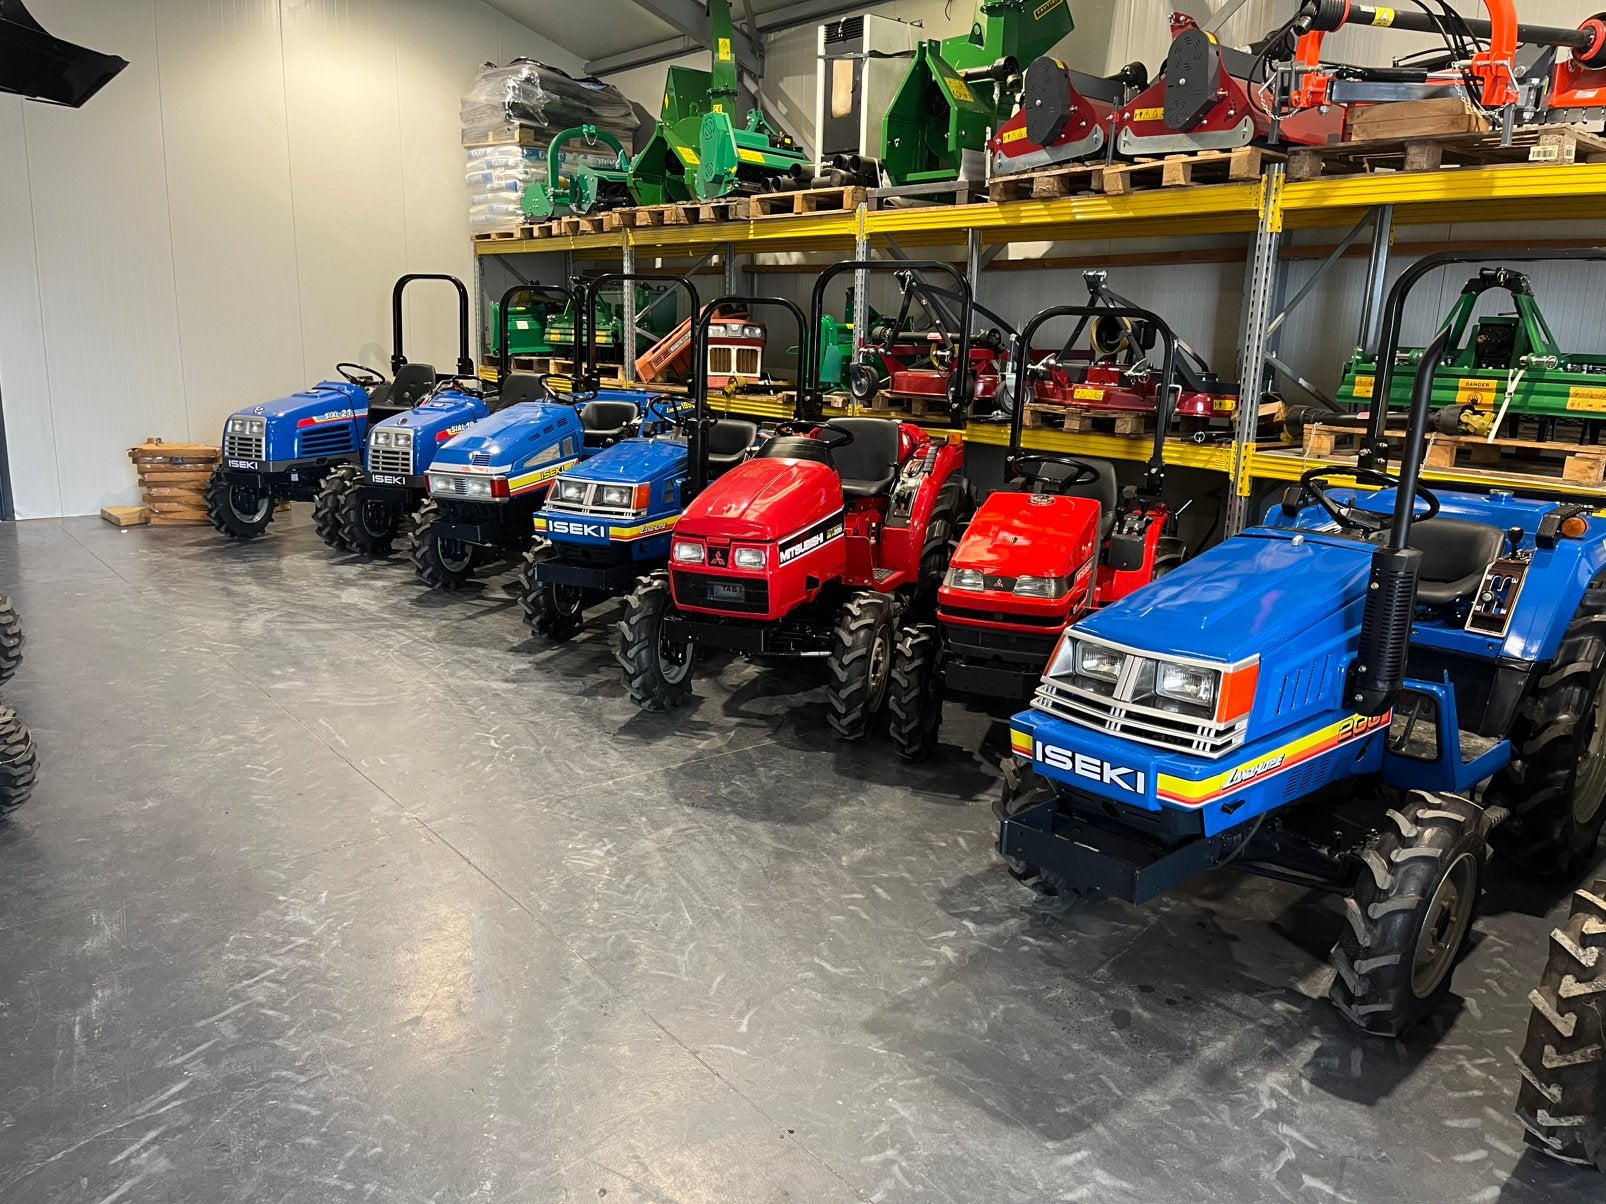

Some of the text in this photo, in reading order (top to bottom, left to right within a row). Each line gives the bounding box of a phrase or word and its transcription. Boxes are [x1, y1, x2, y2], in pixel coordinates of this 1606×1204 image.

[451, 423, 465, 433] SIAL
[228, 459, 258, 470] ISEKI
[540, 464, 565, 480] ISEKI
[372, 474, 406, 485] ISEKI
[548, 519, 605, 538] ISEKI
[1035, 739, 1146, 795] ISEKI
